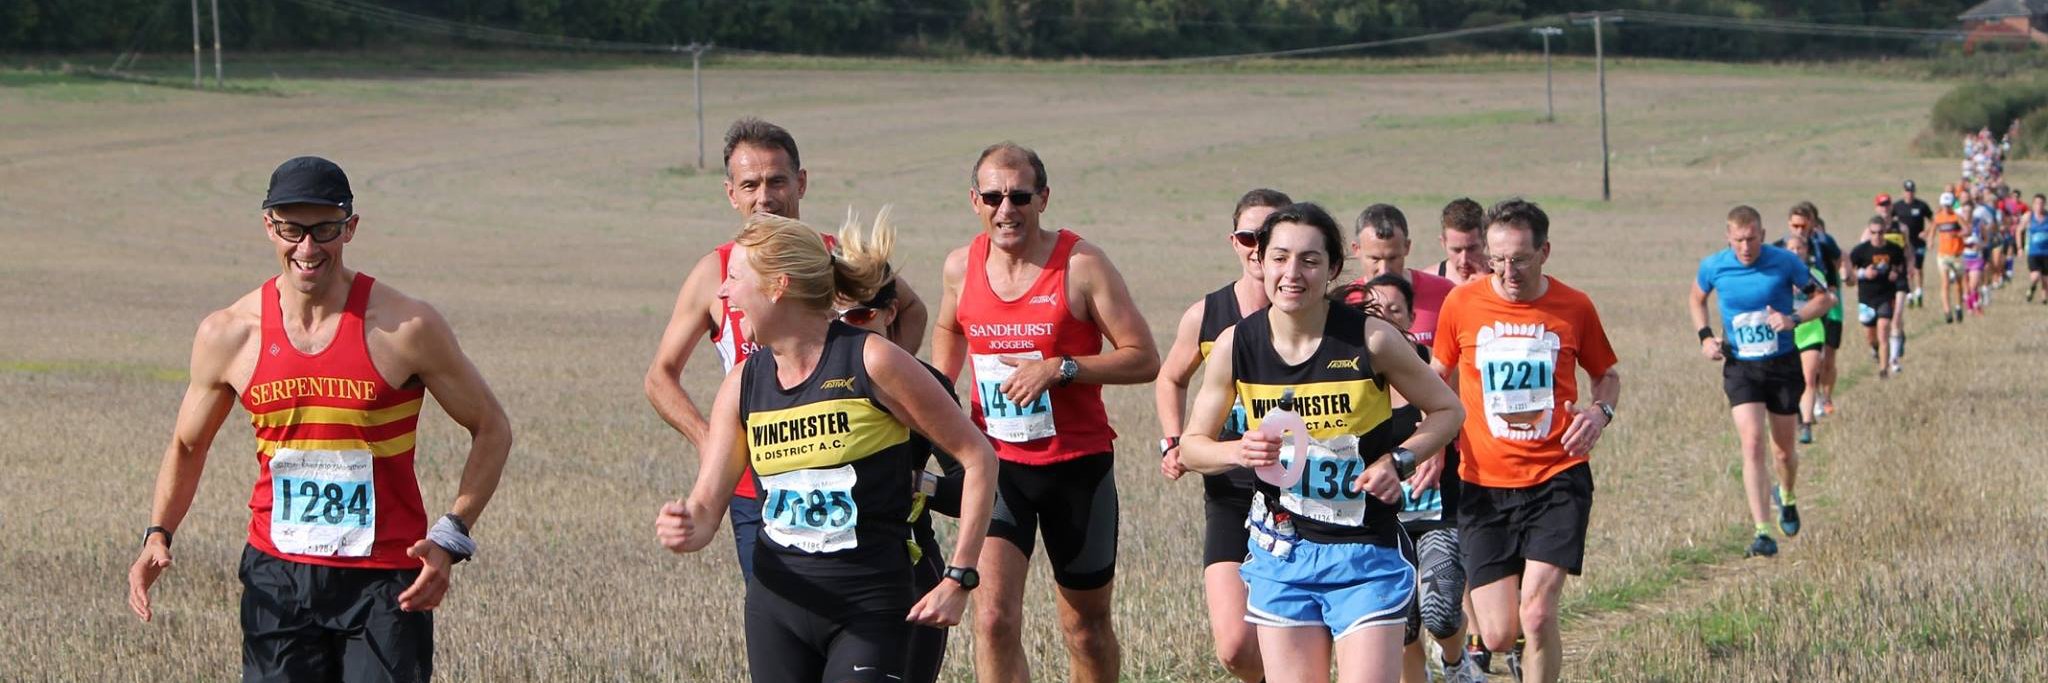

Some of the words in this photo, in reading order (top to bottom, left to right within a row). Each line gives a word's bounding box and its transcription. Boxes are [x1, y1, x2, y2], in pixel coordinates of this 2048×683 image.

[969, 323, 1054, 337] SANDHURST
[1736, 324, 1775, 344] 1358
[741, 342, 764, 355] SA
[988, 339, 1035, 350] JOGGERS
[1487, 361, 1546, 391] 1221
[250, 376, 377, 406] SERPENTINE
[1252, 393, 1352, 419] WIHESTER
[752, 411, 850, 448] WINCHESTER
[1324, 419, 1348, 429] A.C.
[755, 452, 761, 462] &
[765, 445, 814, 461] DISTRICT
[818, 439, 846, 451] A.C.
[1281, 459, 1362, 499] 136
[282, 479, 370, 526] 1284
